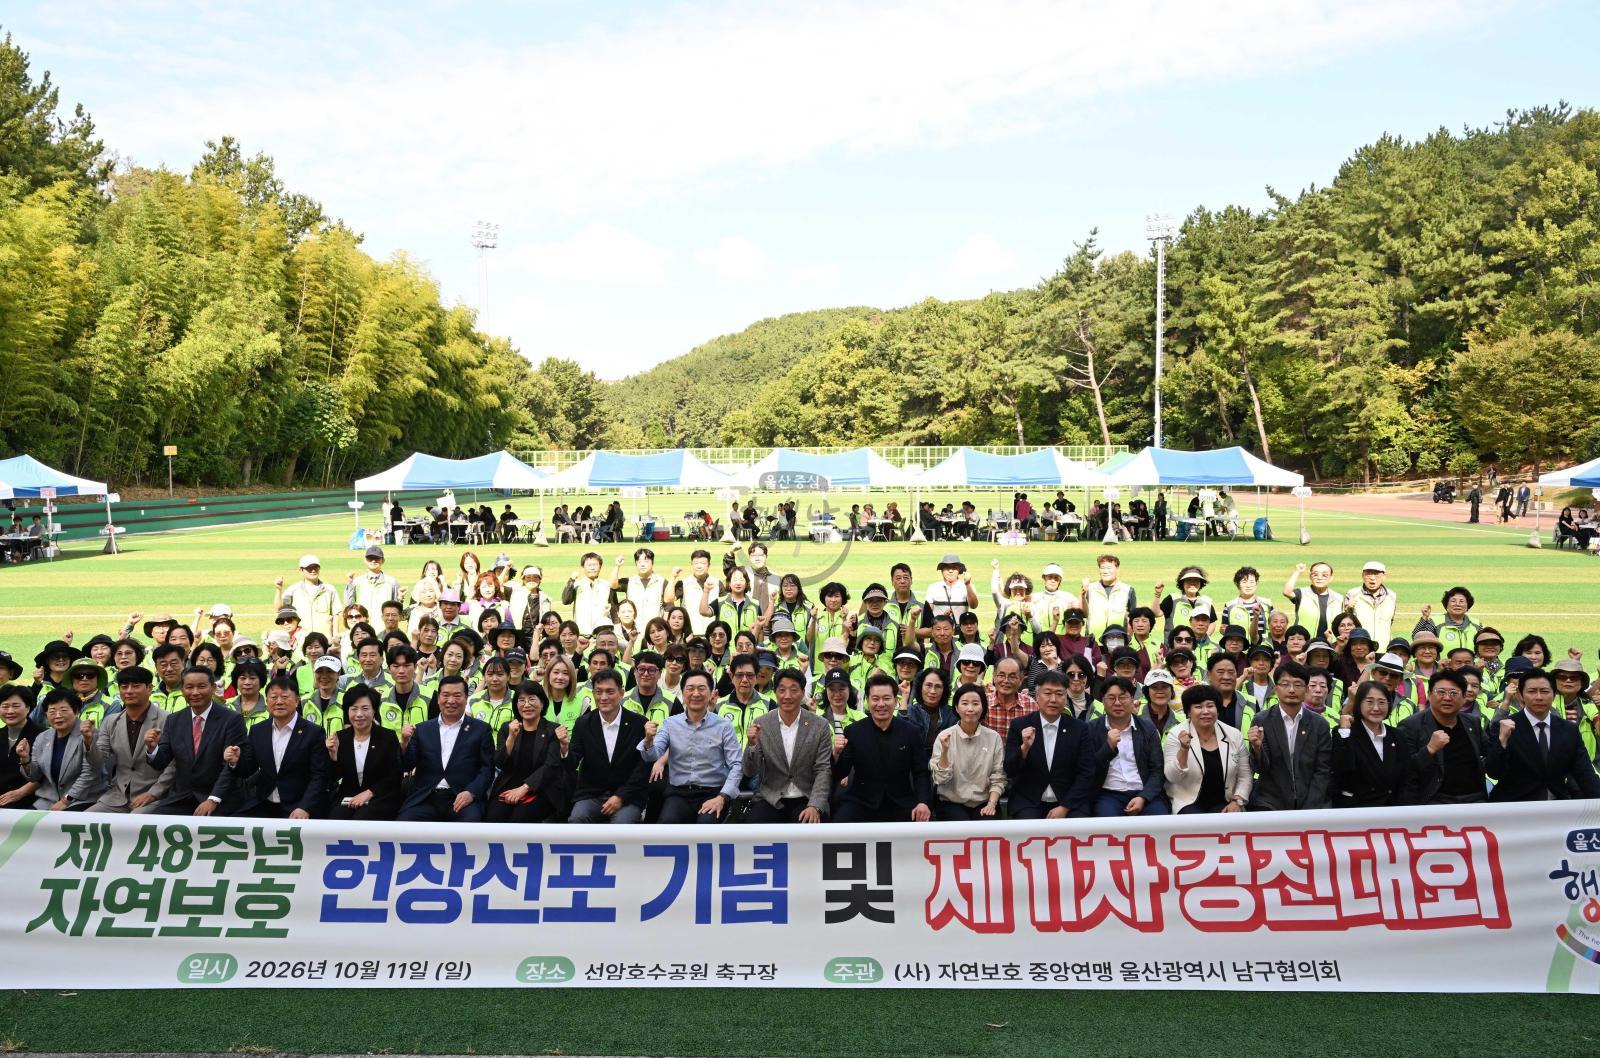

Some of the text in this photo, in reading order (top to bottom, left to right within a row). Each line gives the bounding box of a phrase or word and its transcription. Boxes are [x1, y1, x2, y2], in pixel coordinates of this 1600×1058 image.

[54, 822, 304, 874] 제 48주년
[319, 840, 616, 924] 헌장선포
[640, 842, 788, 925] 기념
[822, 841, 895, 924] 및
[1169, 825, 1513, 933] 경진대회
[25, 876, 296, 938] 자연보호
[187, 957, 230, 980] 일시
[244, 960, 472, 981] 2026년 10월 11일 (일)
[524, 962, 567, 981] 장소
[584, 962, 778, 981] 선암호수공원 축구장
[832, 962, 876, 981] 주관
[893, 960, 1342, 982] (사) 자연보호 중앙연맹 울산광역시 남구협의회
